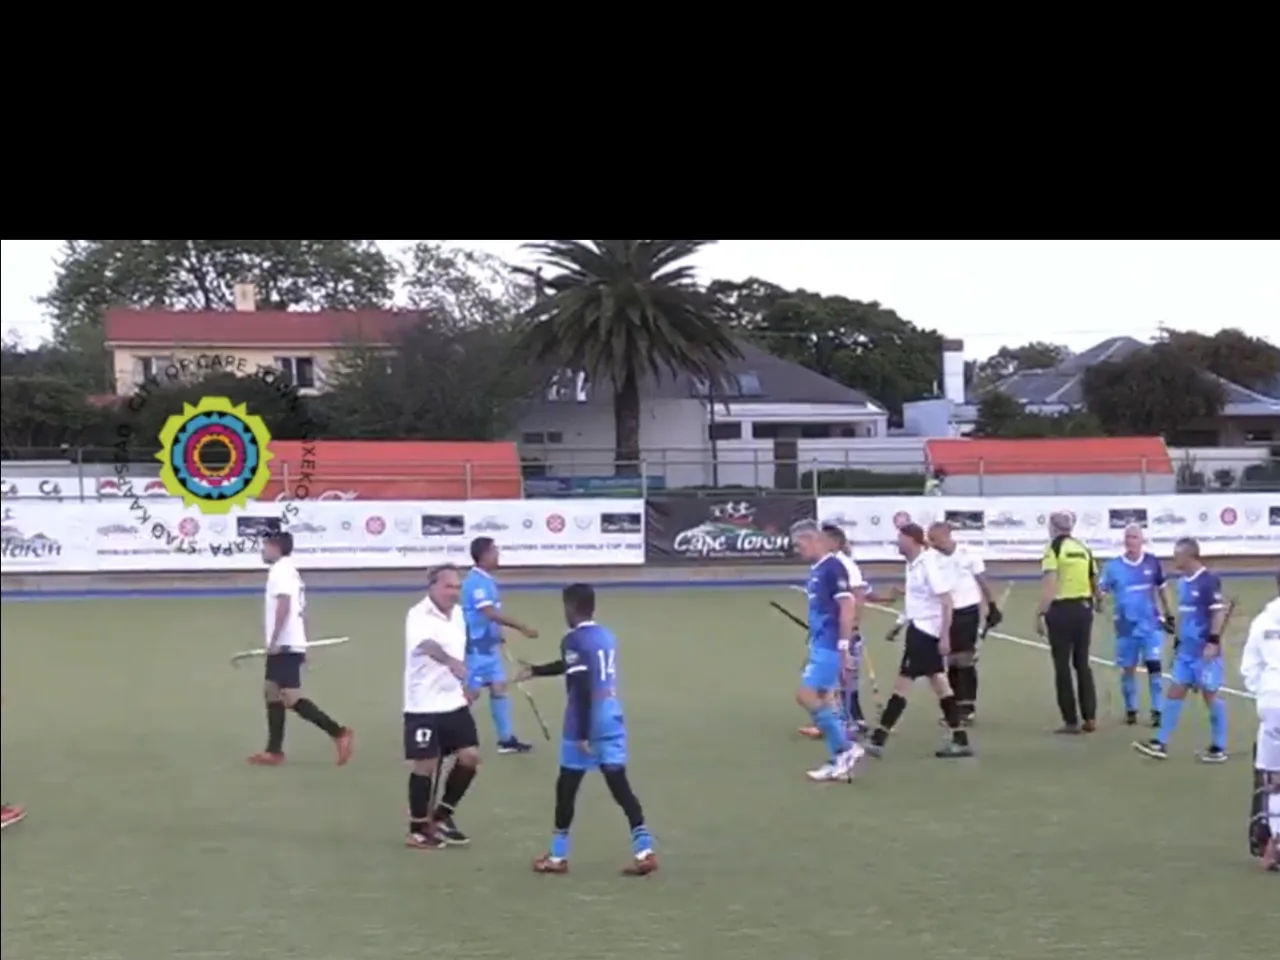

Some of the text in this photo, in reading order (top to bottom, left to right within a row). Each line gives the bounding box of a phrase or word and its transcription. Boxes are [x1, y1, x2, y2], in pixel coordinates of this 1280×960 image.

[674, 529, 790, 556] Cape Town
[597, 649, 616, 681] 14
